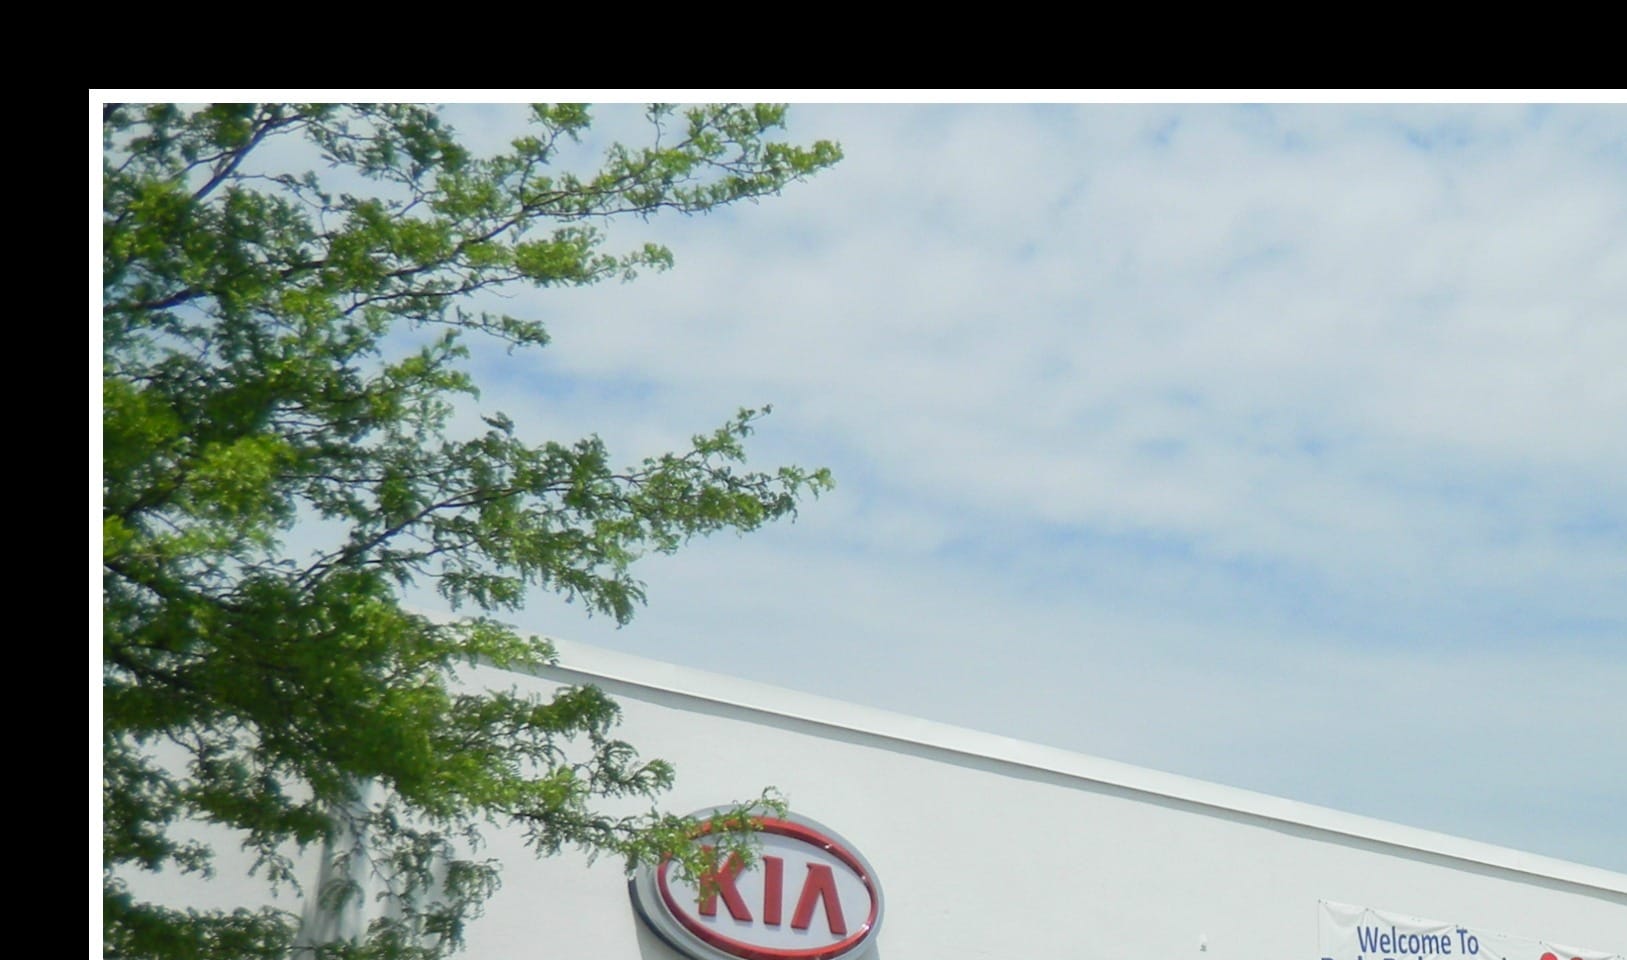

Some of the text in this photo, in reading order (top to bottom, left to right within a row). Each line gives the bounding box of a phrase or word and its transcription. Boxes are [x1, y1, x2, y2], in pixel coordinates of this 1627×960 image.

[696, 843, 848, 935] KIA
[1357, 925, 1479, 956] Welcome To
